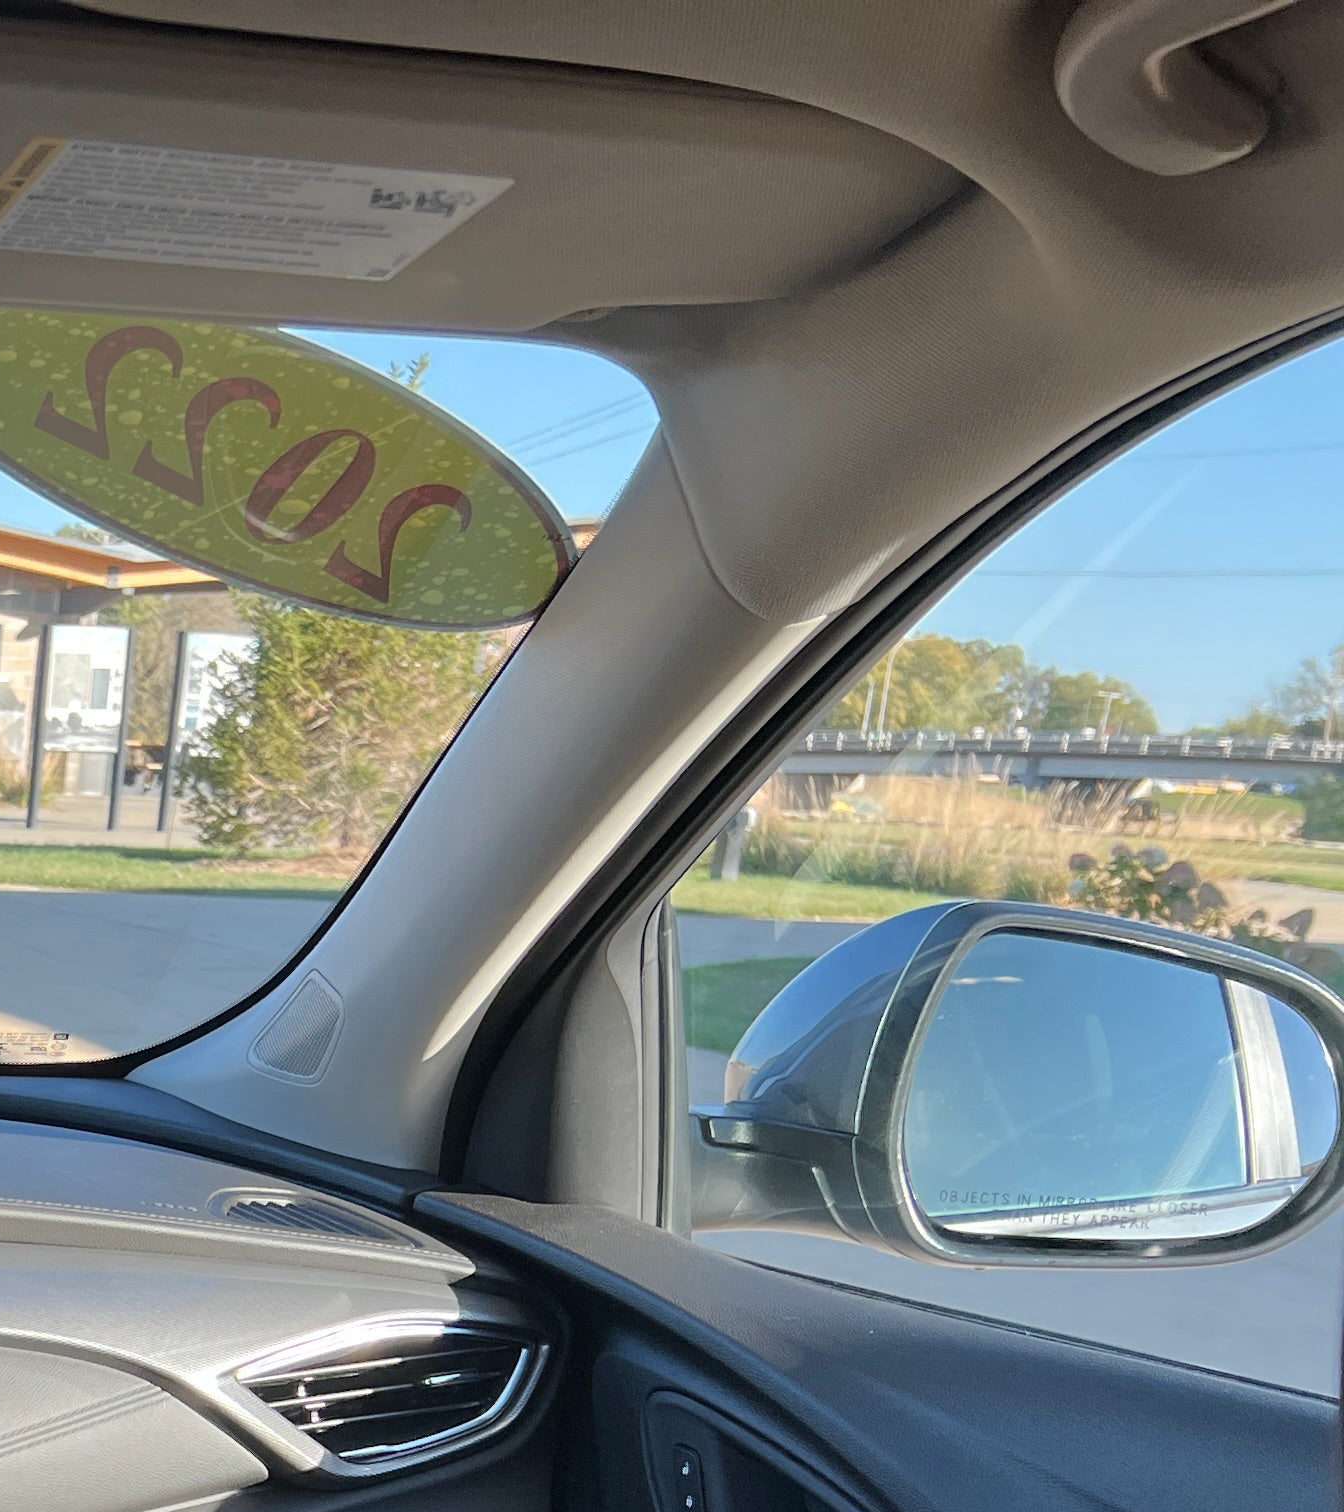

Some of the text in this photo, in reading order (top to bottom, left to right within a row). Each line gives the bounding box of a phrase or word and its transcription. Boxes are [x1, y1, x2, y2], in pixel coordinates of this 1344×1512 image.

[938, 1189, 1011, 1206] OBJECTS
[1016, 1193, 1032, 1207] IN
[1104, 1199, 1137, 1214] ARE
[1146, 1201, 1209, 1217] CLOSER
[1040, 1212, 1081, 1227] THEY
[1089, 1214, 1151, 1230] APPEAR
